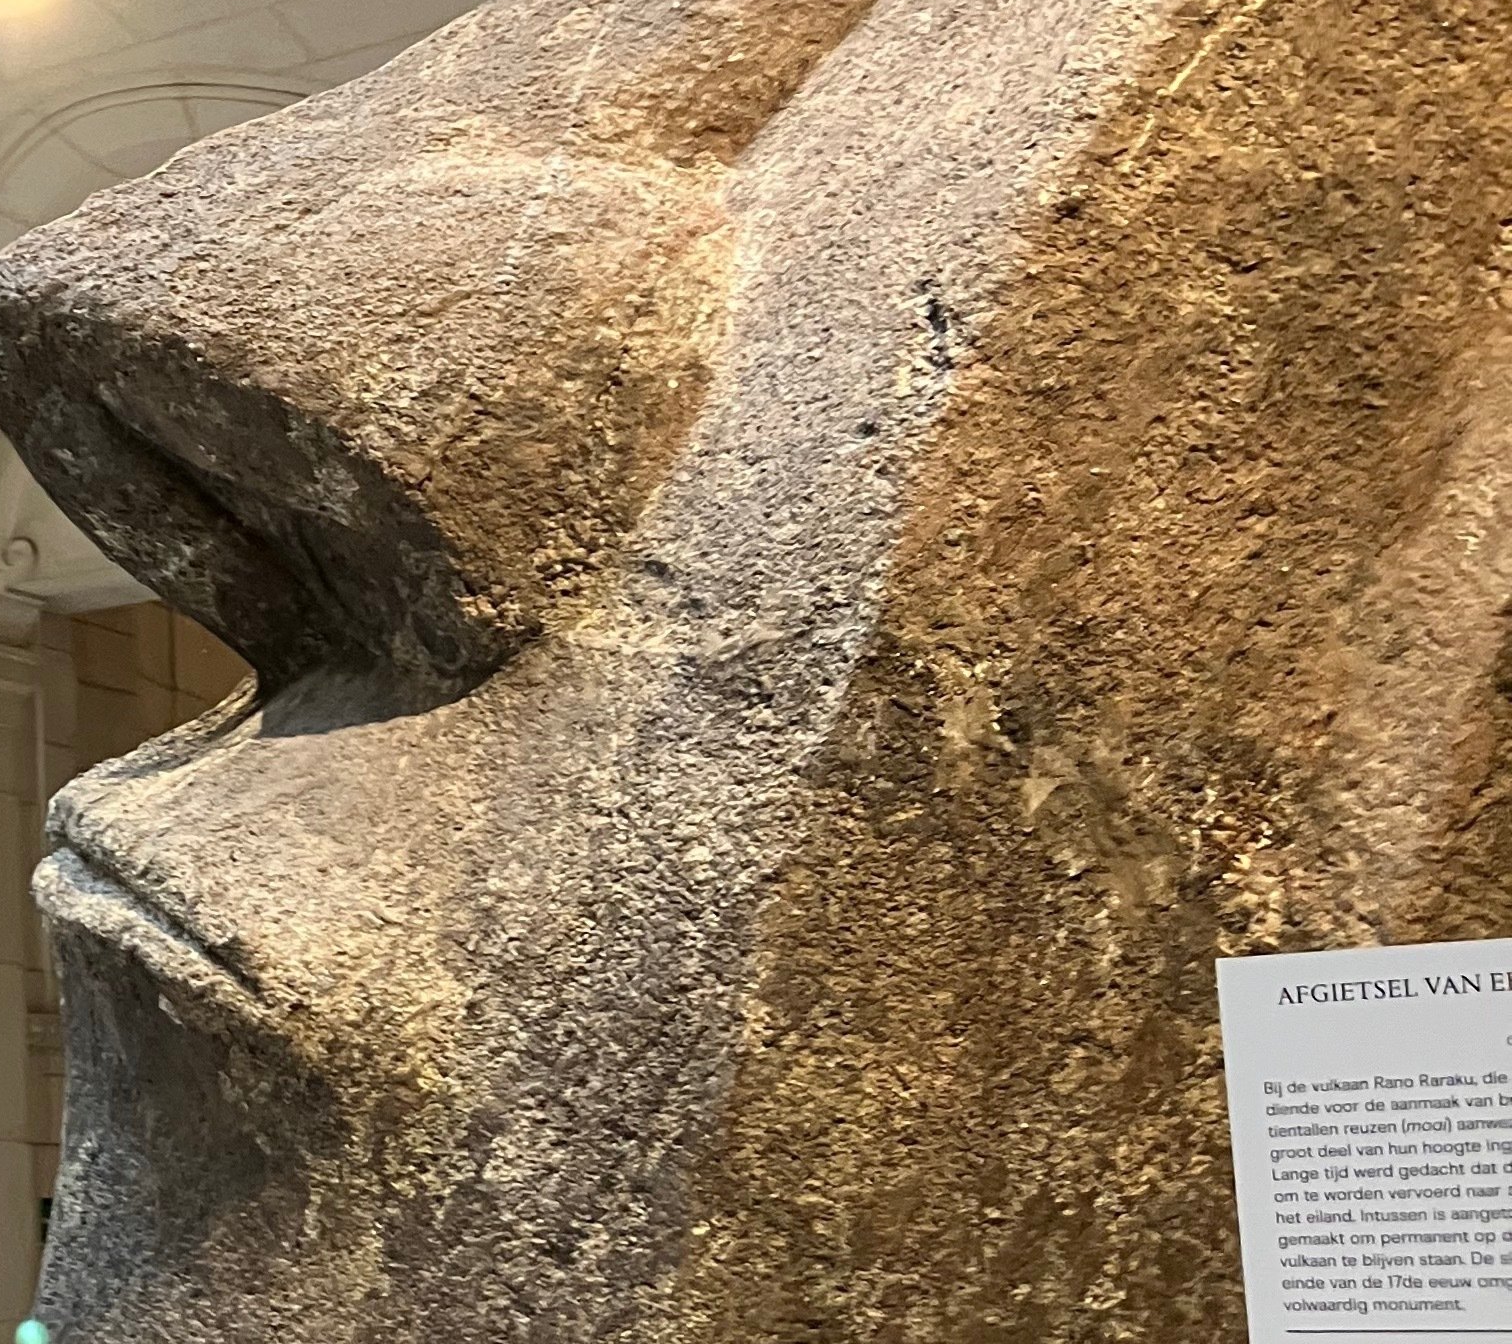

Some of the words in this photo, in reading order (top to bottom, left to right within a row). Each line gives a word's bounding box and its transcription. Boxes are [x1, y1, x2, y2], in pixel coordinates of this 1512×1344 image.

[1279, 978, 1418, 1005] AFGIETSEL
[1425, 974, 1480, 995] VAN
[1264, 1081, 1283, 1098] Bij
[1287, 1081, 1306, 1093] de
[1312, 1079, 1369, 1092] vulkaan
[1374, 1076, 1413, 1088] Rano
[1419, 1074, 1478, 1087] Raraku,
[1483, 1072, 1507, 1084] die
[1266, 1104, 1319, 1116] diende
[1324, 1101, 1358, 1113] voor
[1365, 1099, 1385, 1111] de
[1391, 1095, 1459, 1110] aanmaak
[1465, 1095, 1492, 1107] van
[1269, 1123, 1338, 1137] tientallen
[1344, 1121, 1396, 1134] reuzen
[1270, 1147, 1312, 1162] groot
[1318, 1144, 1351, 1157] deel
[1356, 1144, 1383, 1156] van
[1388, 1143, 1417, 1155] hun
[1423, 1140, 1480, 1156] hoogte
[1273, 1169, 1319, 1183] Lange
[1324, 1166, 1348, 1182] tijd
[1353, 1165, 1393, 1178] werd
[1399, 1163, 1464, 1180] gedacht
[1471, 1163, 1497, 1175] dat
[1274, 1191, 1299, 1203] om
[1304, 1190, 1318, 1202] te
[1324, 1188, 1383, 1201] worden
[1388, 1185, 1460, 1199] vervoerd
[1466, 1186, 1500, 1197] naar
[1276, 1212, 1300, 1224] het
[1361, 1209, 1426, 1222] Intussen
[1433, 1208, 1446, 1221] is
[1279, 1232, 1344, 1249] gemaakt
[1350, 1233, 1375, 1245] om
[1381, 1231, 1469, 1247] permanent
[1474, 1231, 1496, 1244] op
[1280, 1255, 1336, 1268] vulkaan
[1342, 1255, 1356, 1267] te
[1362, 1254, 1413, 1269] blijven
[1471, 1251, 1493, 1265] De
[1282, 1277, 1324, 1290] einde
[1330, 1278, 1356, 1289] van
[1362, 1276, 1382, 1288] de
[1388, 1275, 1422, 1288] 17de
[1428, 1277, 1471, 1288] eeuw
[1284, 1298, 1367, 1314] volwaardig
[1373, 1298, 1466, 1311] monument.
